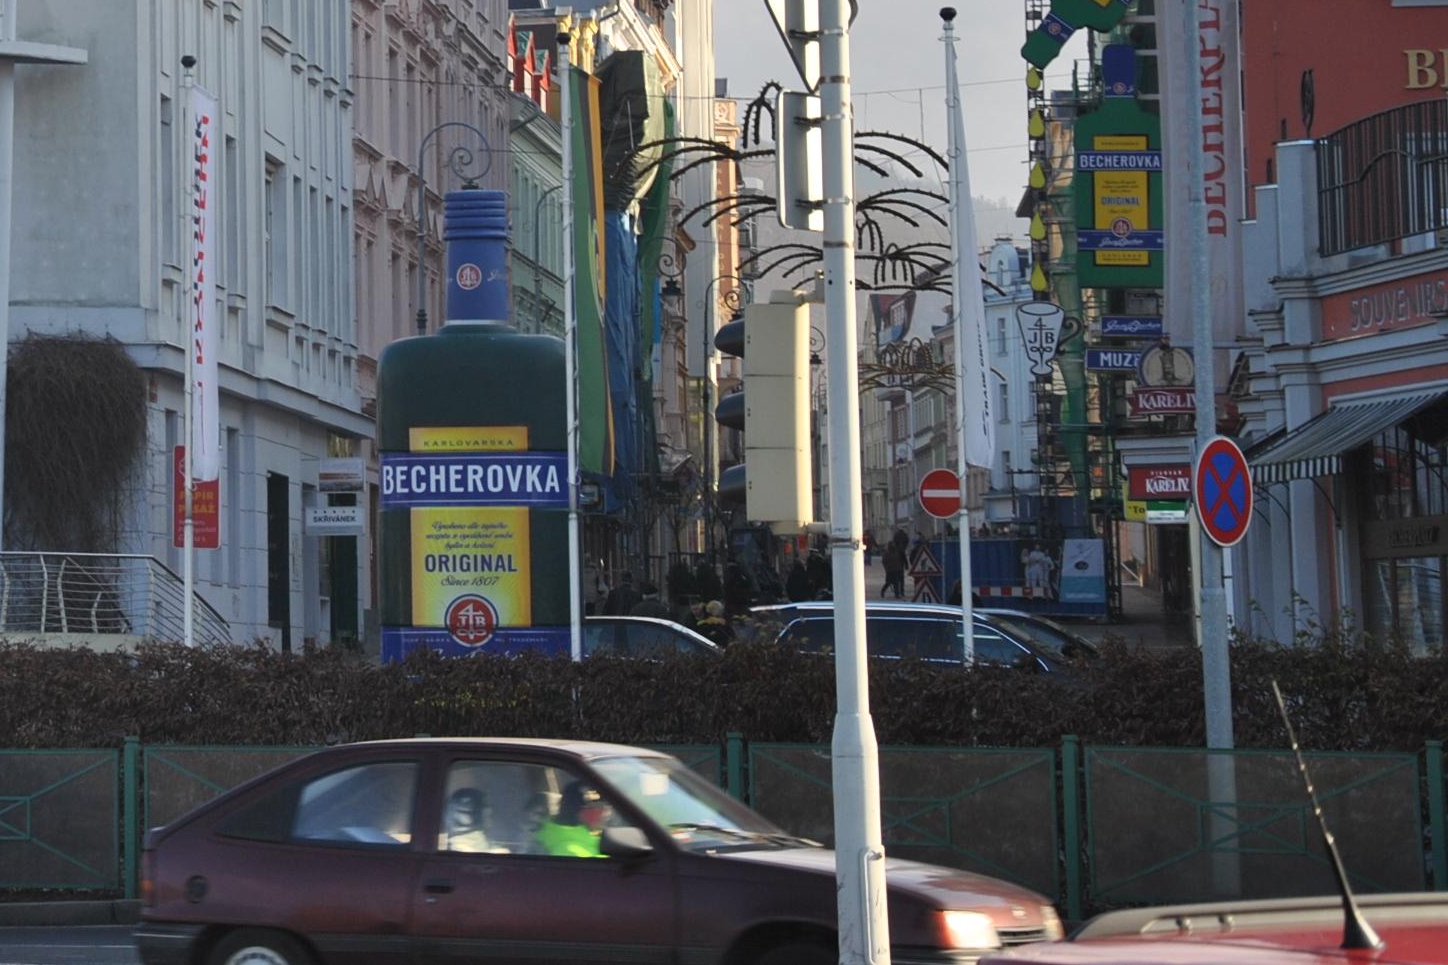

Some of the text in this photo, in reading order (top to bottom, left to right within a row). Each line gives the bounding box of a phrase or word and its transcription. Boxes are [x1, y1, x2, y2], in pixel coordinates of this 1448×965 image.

[1079, 154, 1161, 168] BECHEROVKA
[1138, 393, 1185, 410] KAREL
[382, 464, 560, 495] BECHEROVKA
[313, 514, 356, 523] SKŘIVÁNEK
[424, 554, 518, 573] ORIGINAL
[441, 574, 500, 586] Since 1807
